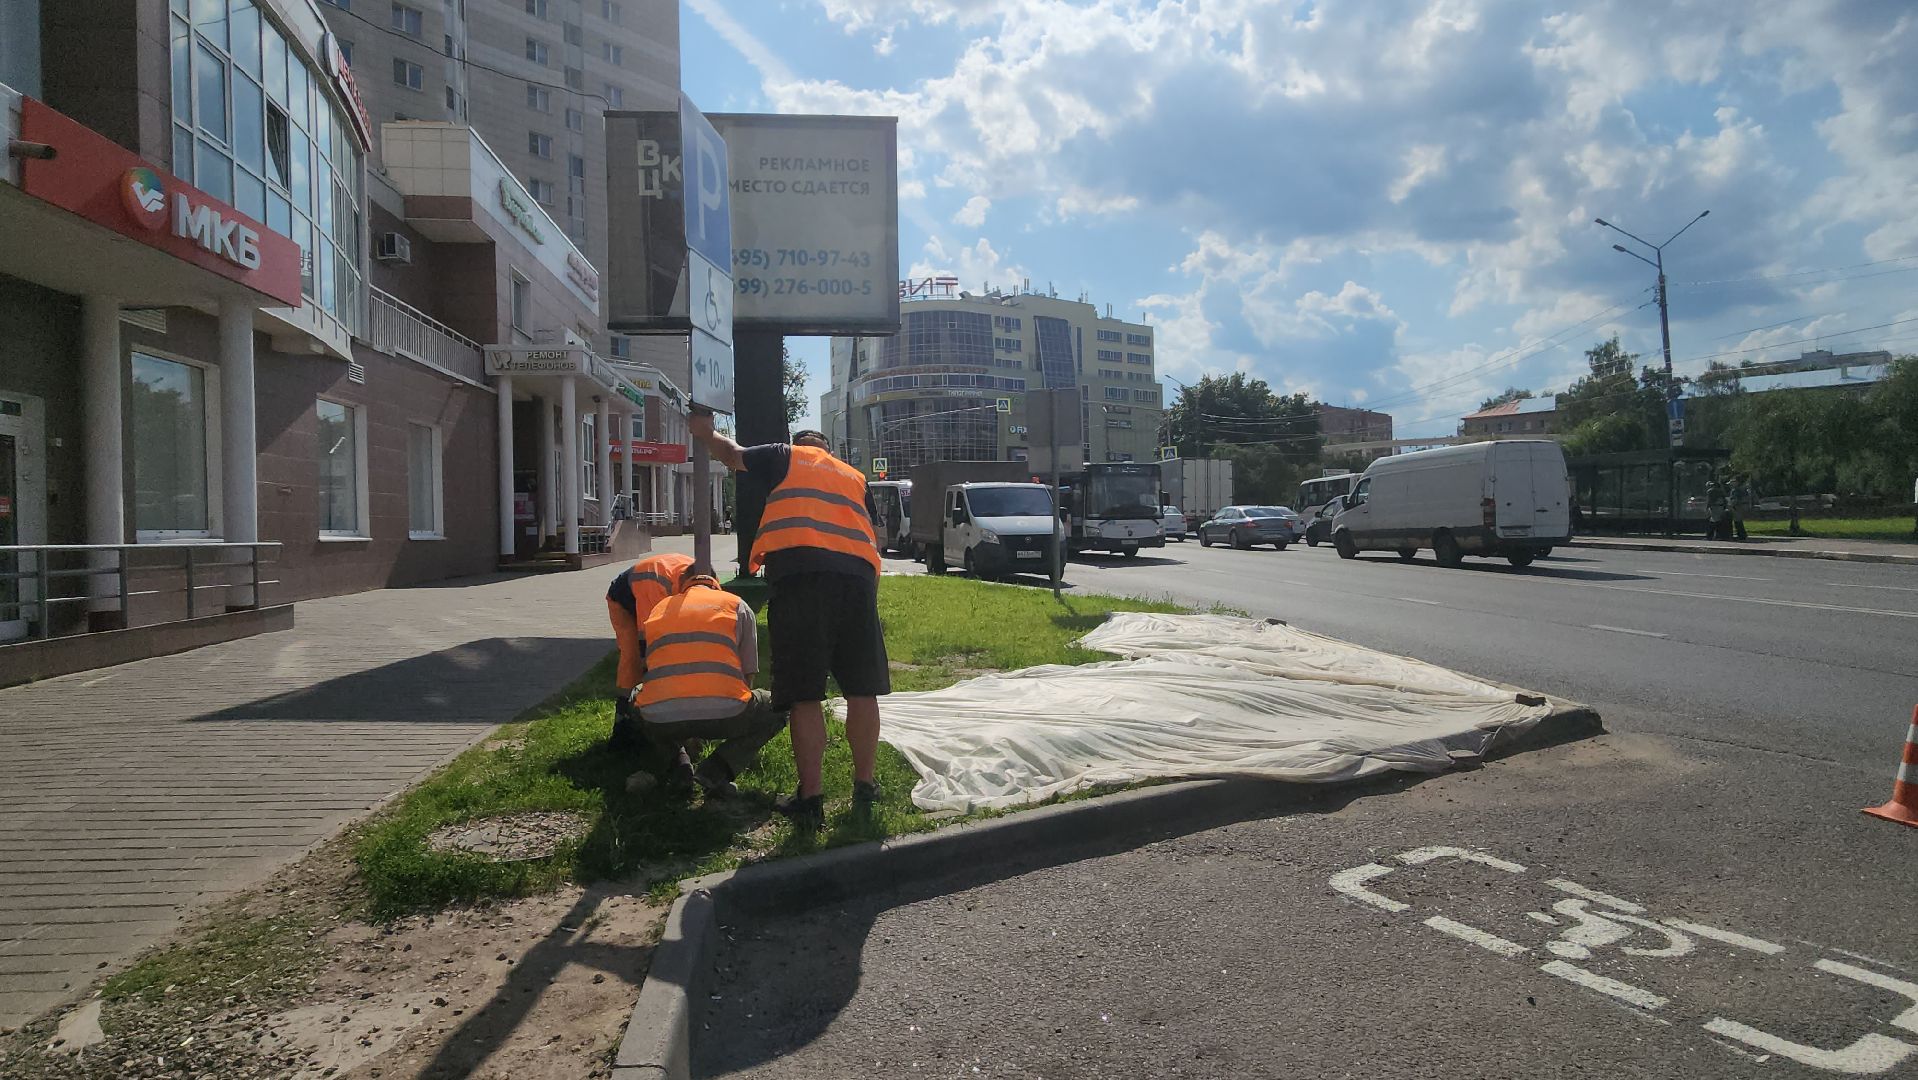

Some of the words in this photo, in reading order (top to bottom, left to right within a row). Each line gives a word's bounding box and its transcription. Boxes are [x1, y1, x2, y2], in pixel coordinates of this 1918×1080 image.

[760, 157, 870, 172] РЕКЛАМНОЕ
[696, 127, 721, 240] P
[729, 180, 787, 193] МЕСТО
[791, 180, 870, 196] СДАЕТСЯ
[172, 192, 261, 271] МКБ
[776, 249, 871, 267] 710-97-43
[774, 278, 872, 296] 276-000-5
[526, 351, 568, 360] РЕМОНТ
[512, 362, 576, 370] ТЕЛЕФОНОВ
